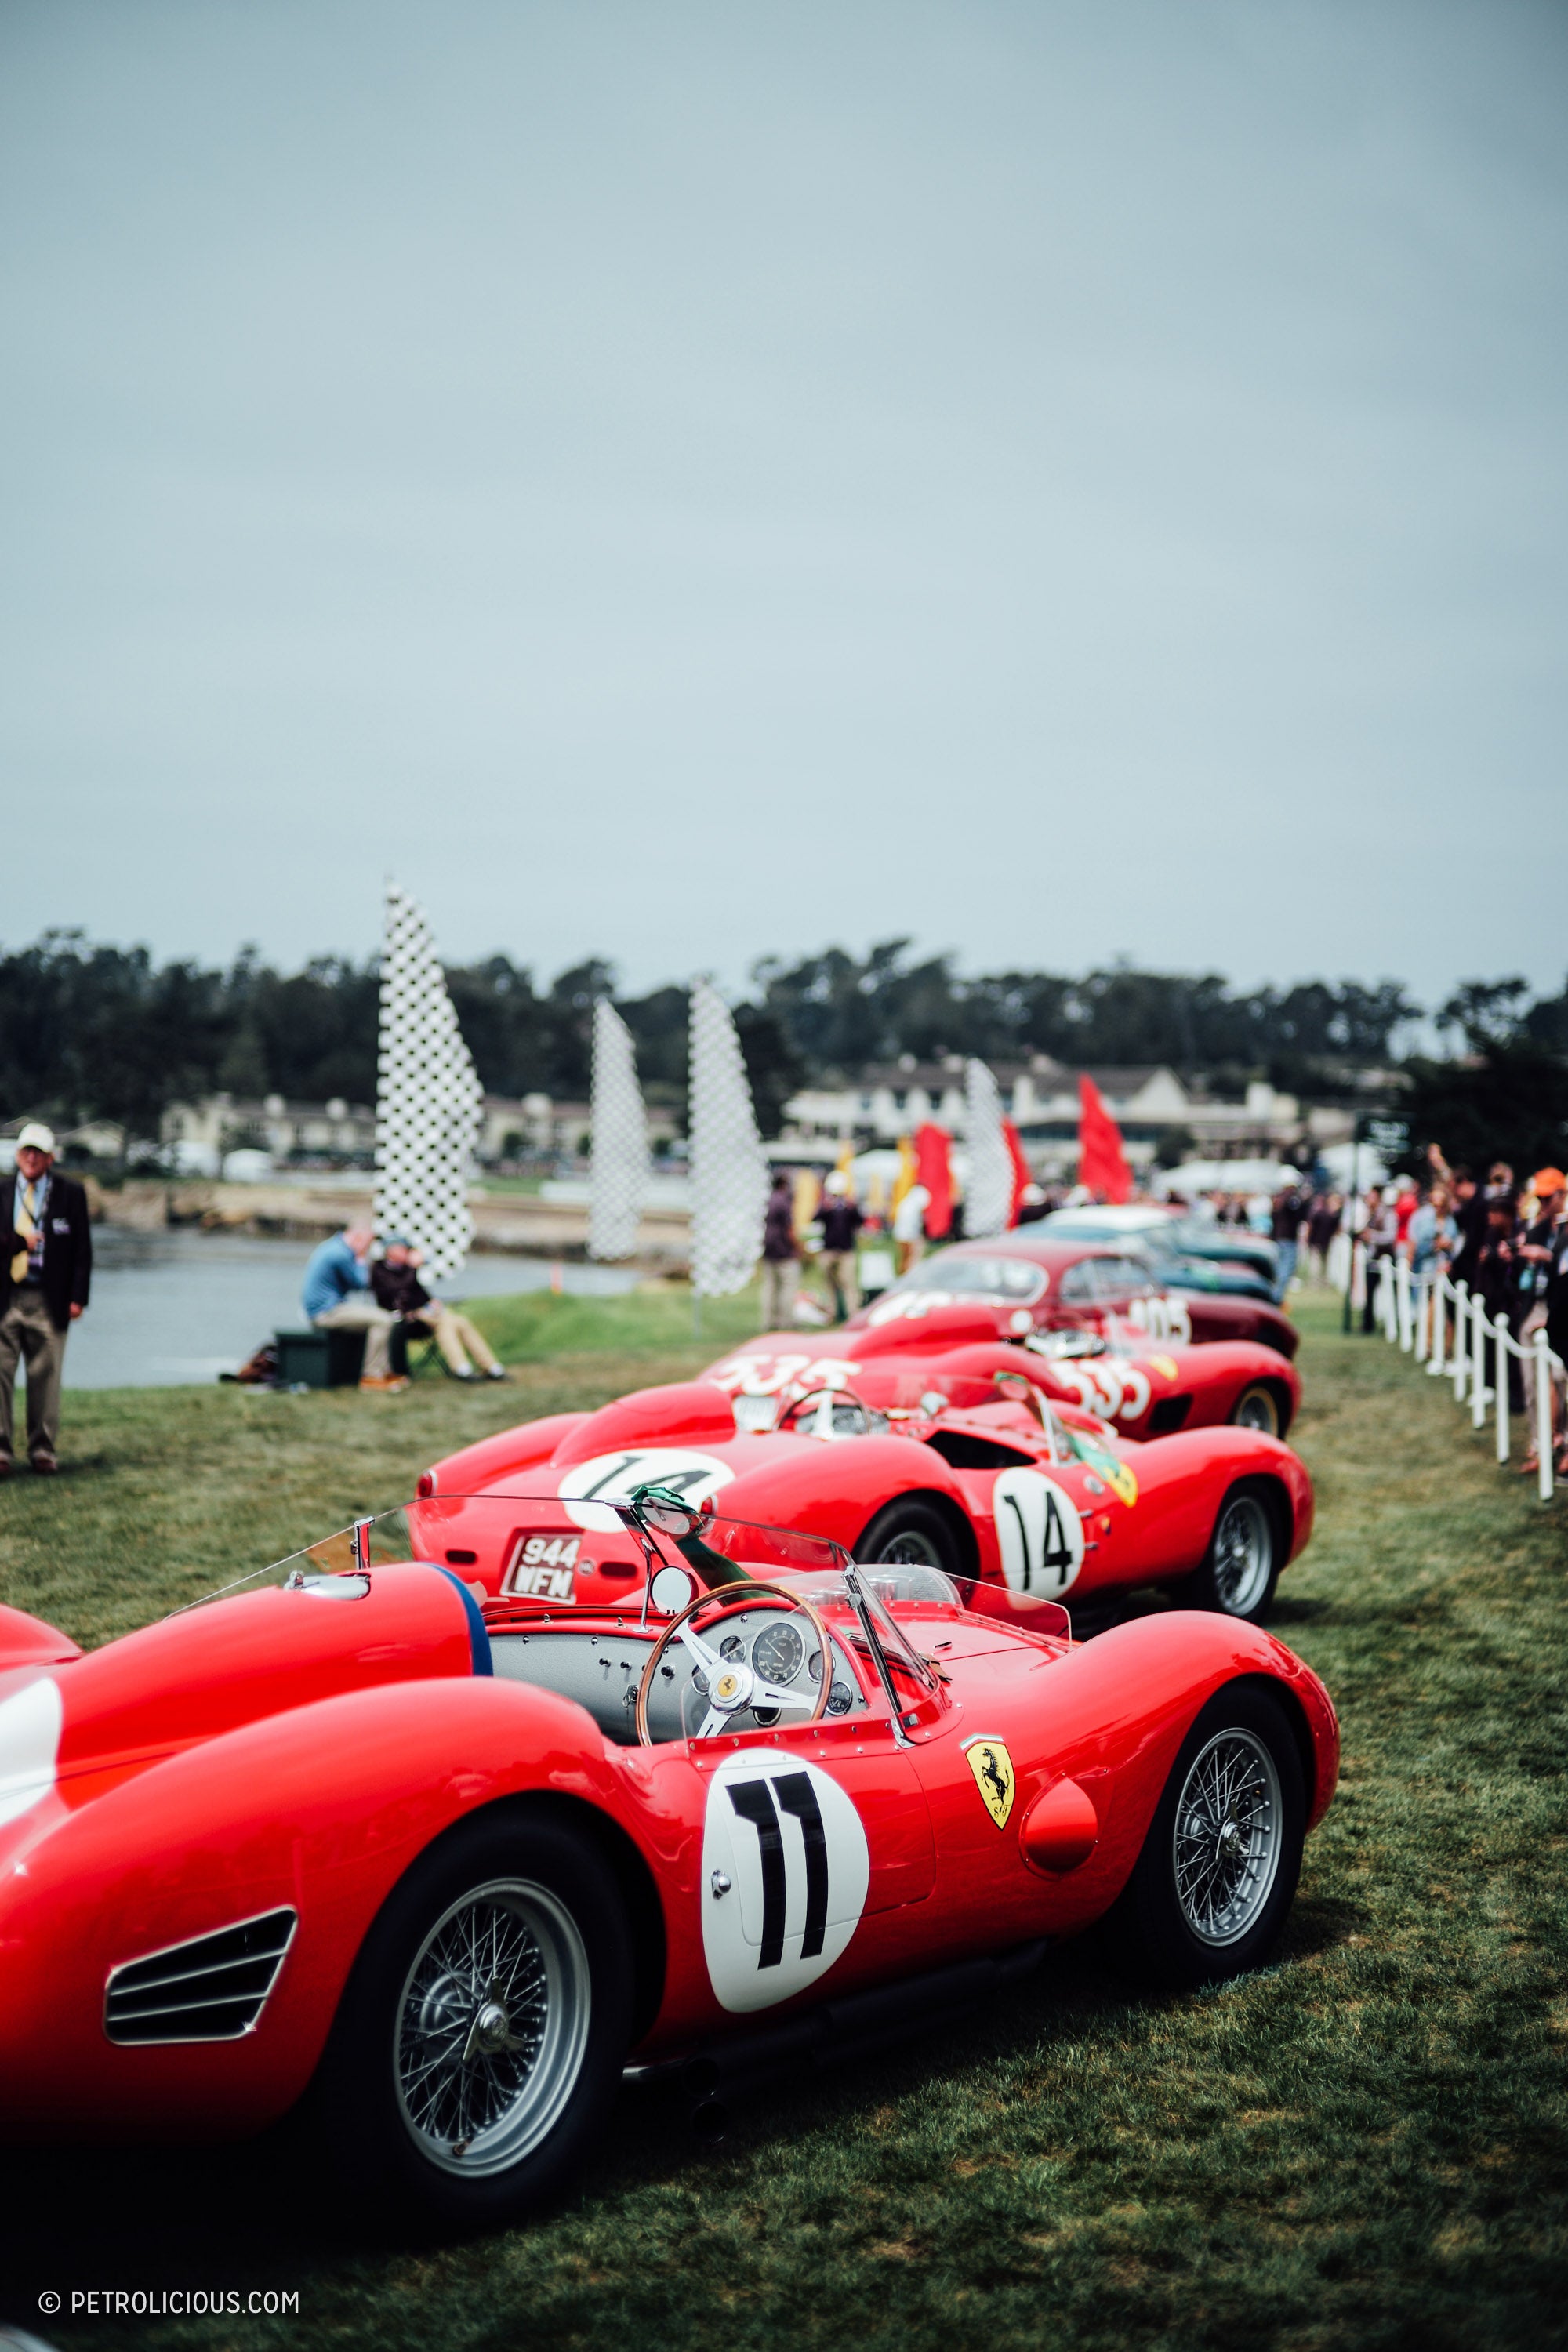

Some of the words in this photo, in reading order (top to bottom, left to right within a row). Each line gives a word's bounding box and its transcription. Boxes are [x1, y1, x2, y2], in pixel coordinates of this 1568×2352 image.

[521, 1537, 580, 1569] 944
[1003, 1491, 1073, 1591] 14
[725, 1771, 828, 1971] 11
